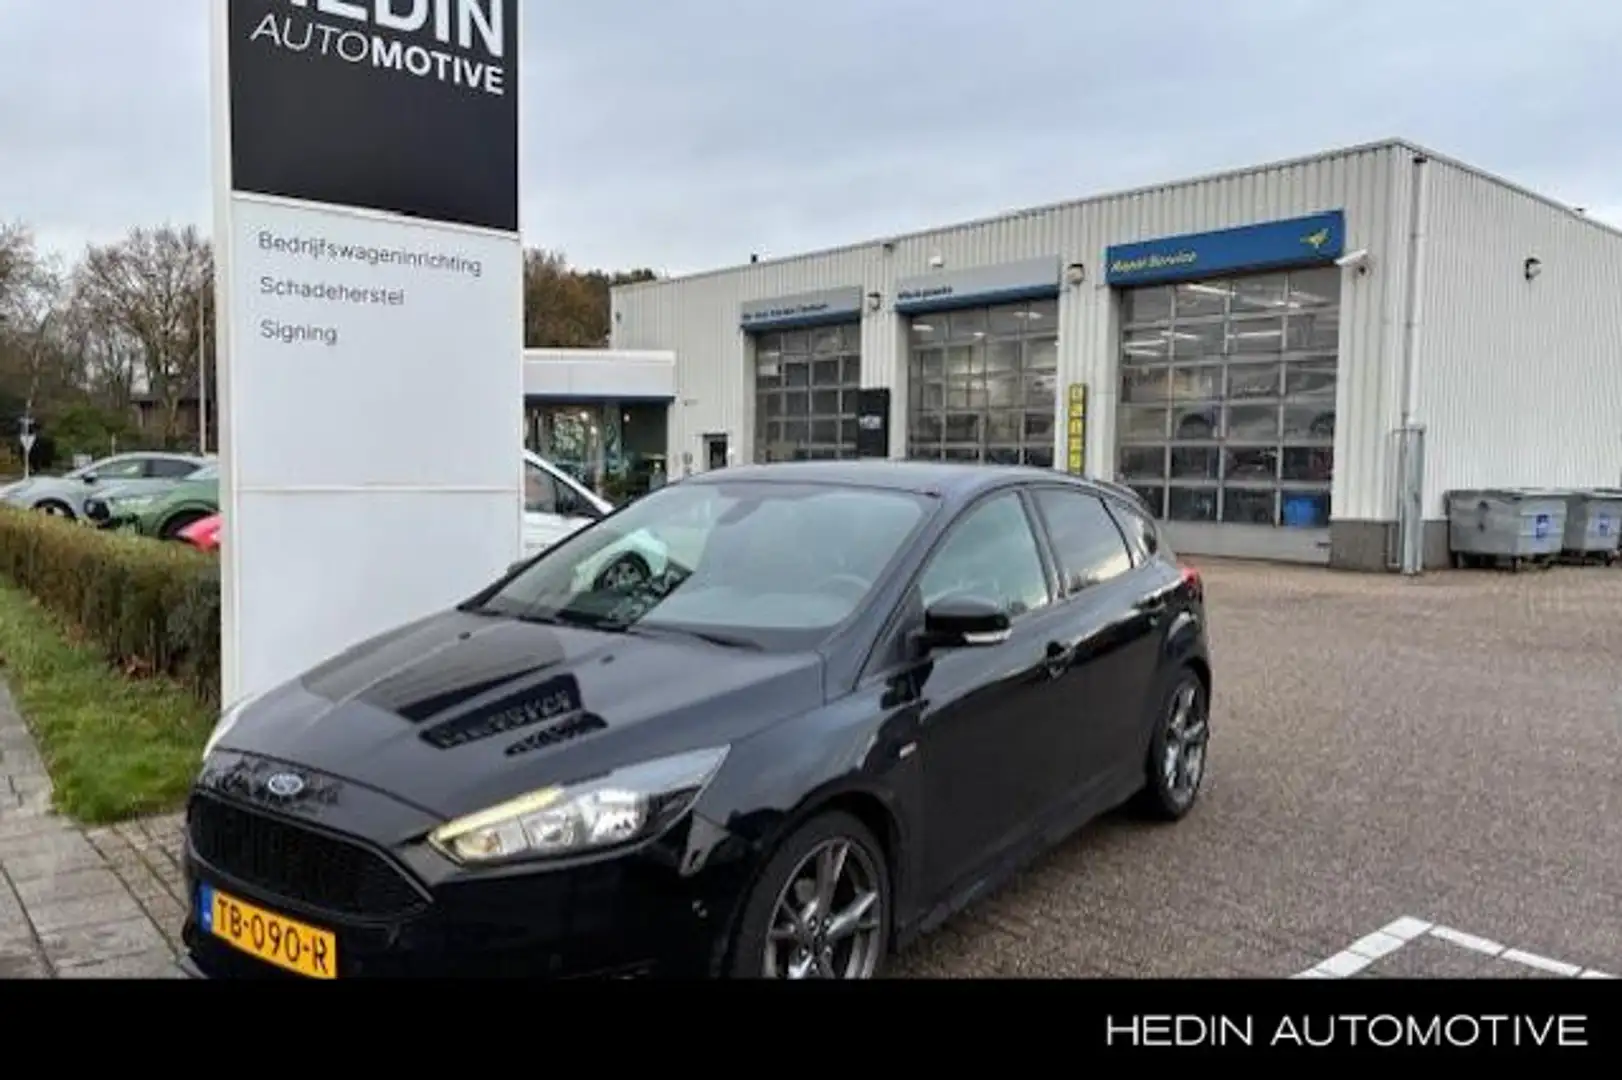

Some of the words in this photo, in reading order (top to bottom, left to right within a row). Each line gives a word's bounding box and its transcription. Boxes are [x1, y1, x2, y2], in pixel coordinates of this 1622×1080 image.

[288, 0, 504, 56] DIN
[250, 13, 504, 95] AUTOMOTIVE
[258, 231, 482, 277] Bedrijfswageninrichting
[260, 276, 404, 305] Schadeherstel
[260, 319, 338, 345] Signing
[216, 898, 329, 975] TB-090-R
